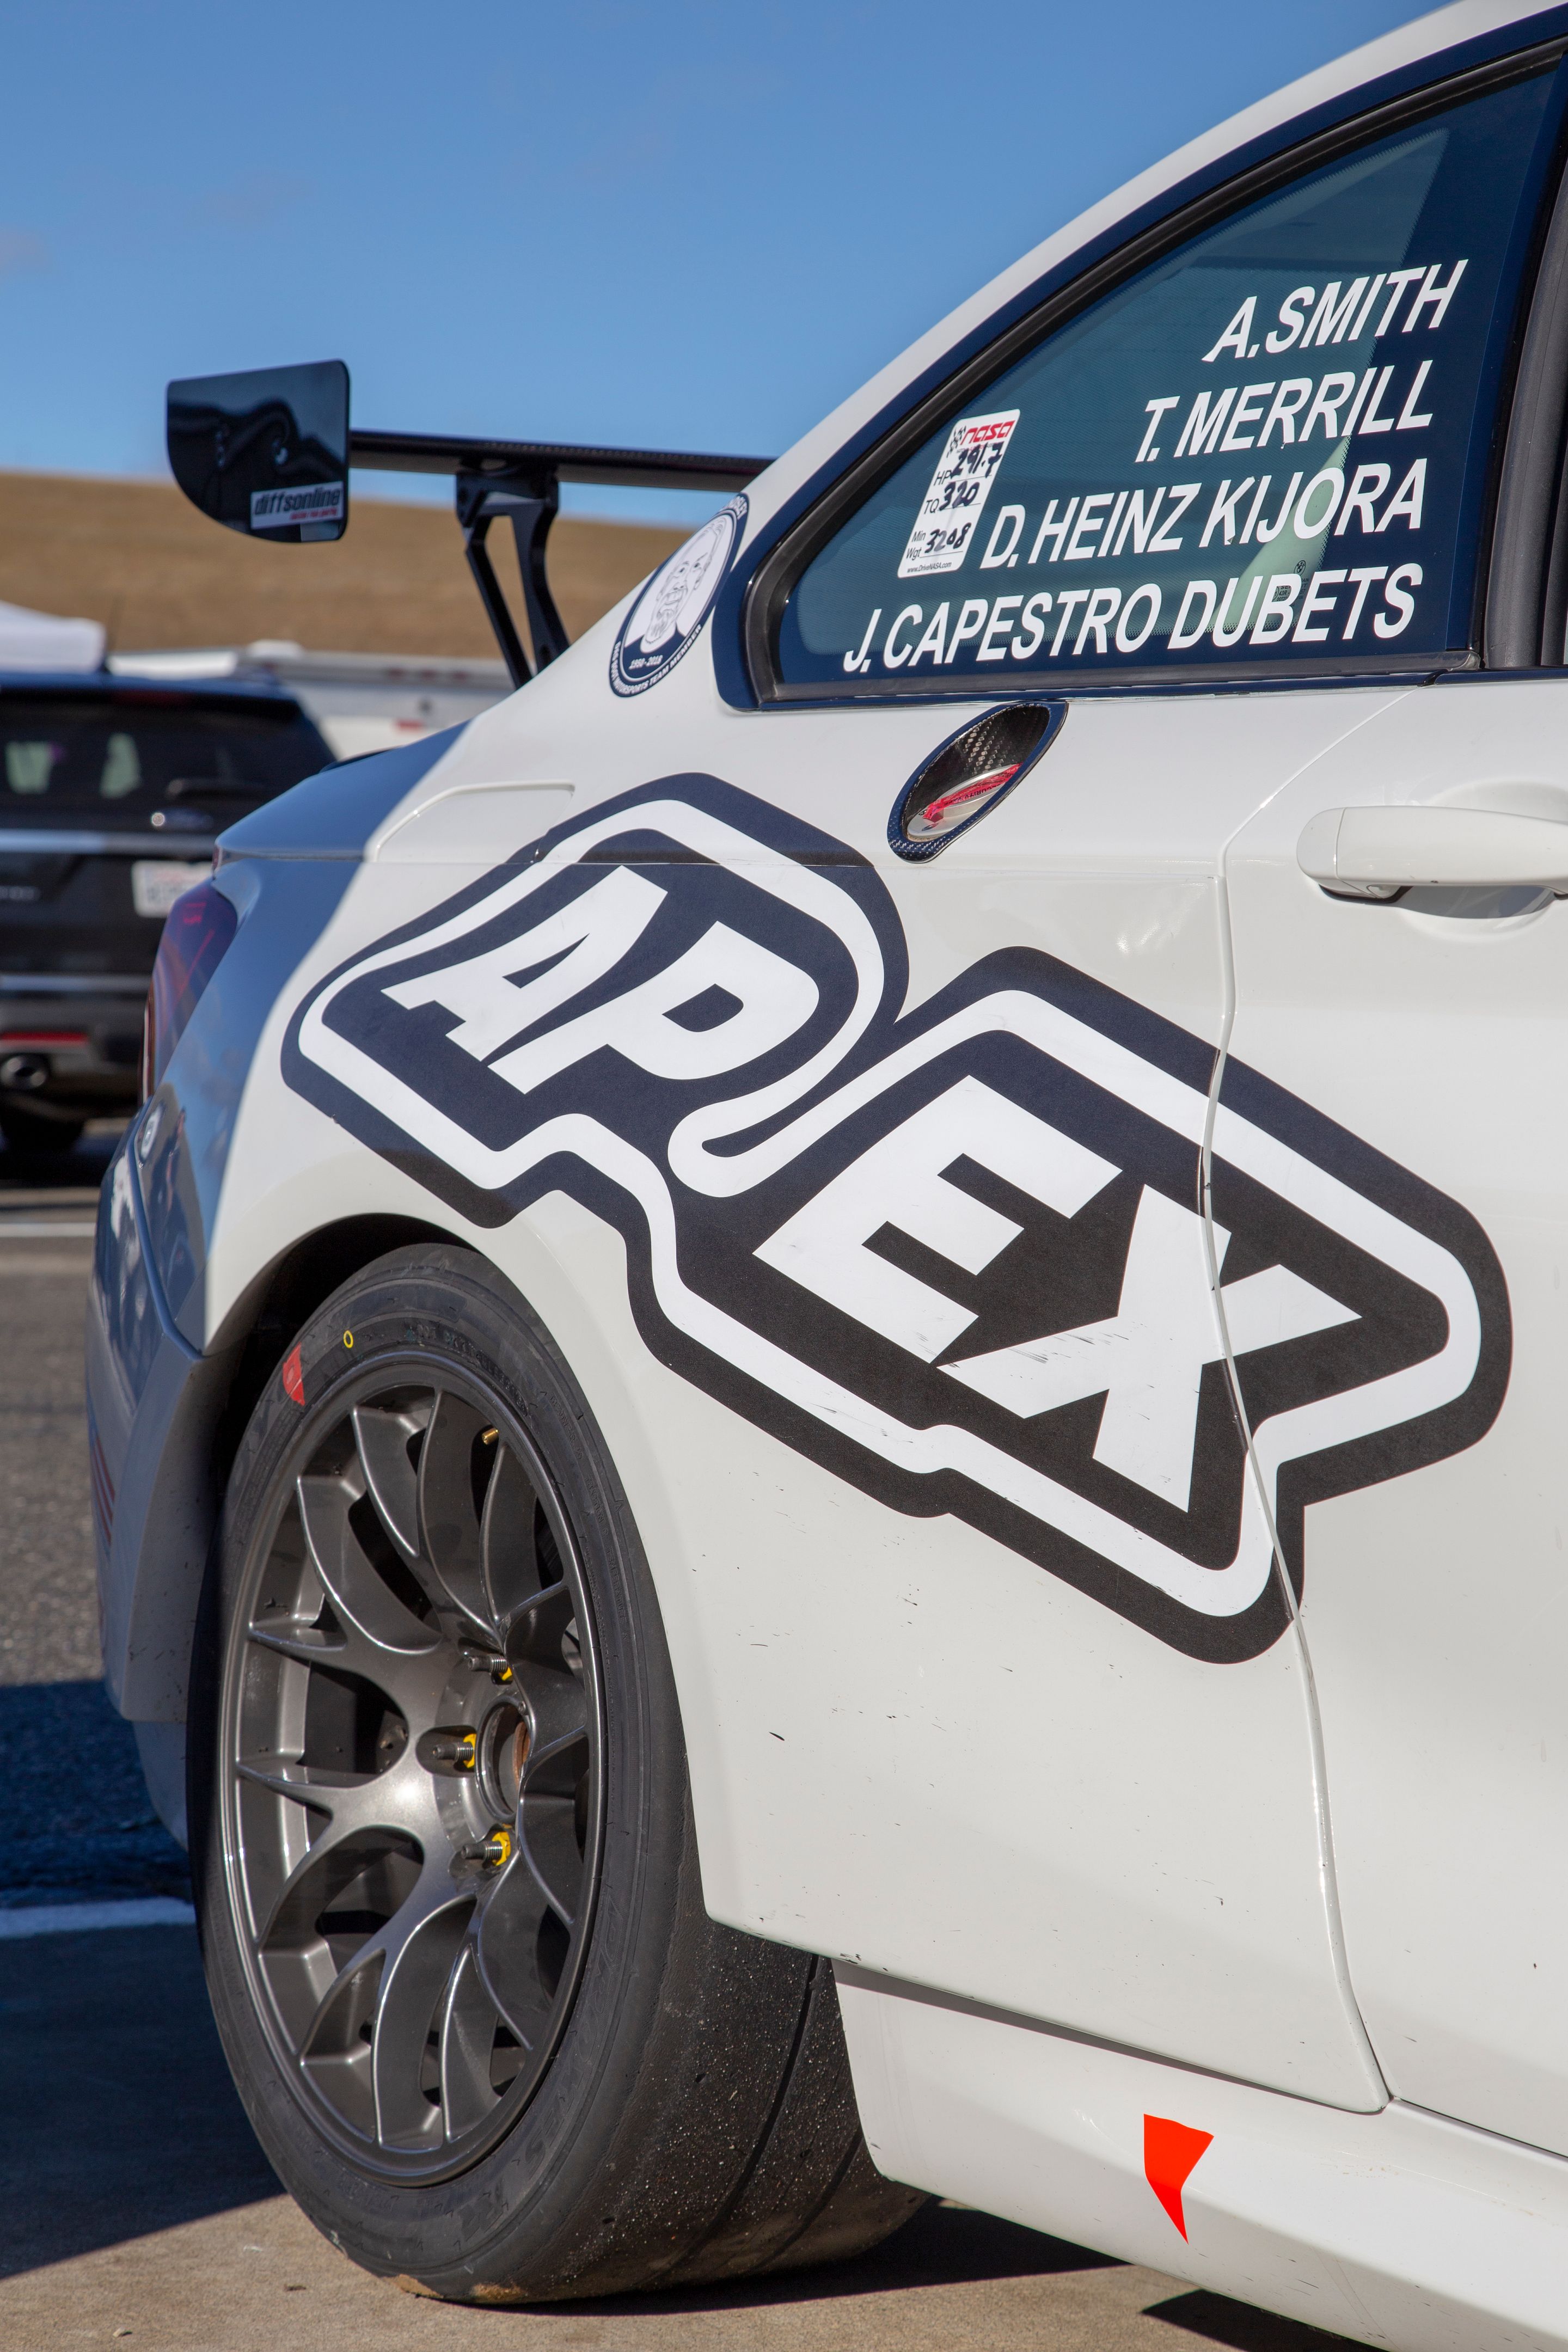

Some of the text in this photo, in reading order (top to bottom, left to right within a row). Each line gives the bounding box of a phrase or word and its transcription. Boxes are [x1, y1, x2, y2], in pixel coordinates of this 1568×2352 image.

[1174, 360, 1432, 457] MERRILL
[924, 480, 981, 514] TQ 320
[934, 470, 953, 486] HP
[255, 486, 341, 515] diffsonline
[1028, 483, 1202, 564] HEINZ
[1199, 458, 1426, 552] KIJORA
[906, 522, 972, 561] Wgt 3208
[911, 531, 927, 543] Min
[906, 561, 952, 573] www.DriveNASA.com
[884, 584, 1161, 668] CAPESTRO
[1168, 564, 1422, 649] DUBETS
[648, 665, 670, 687] TEAM
[669, 624, 702, 669] MEMBER
[382, 866, 1361, 1512] APEX
